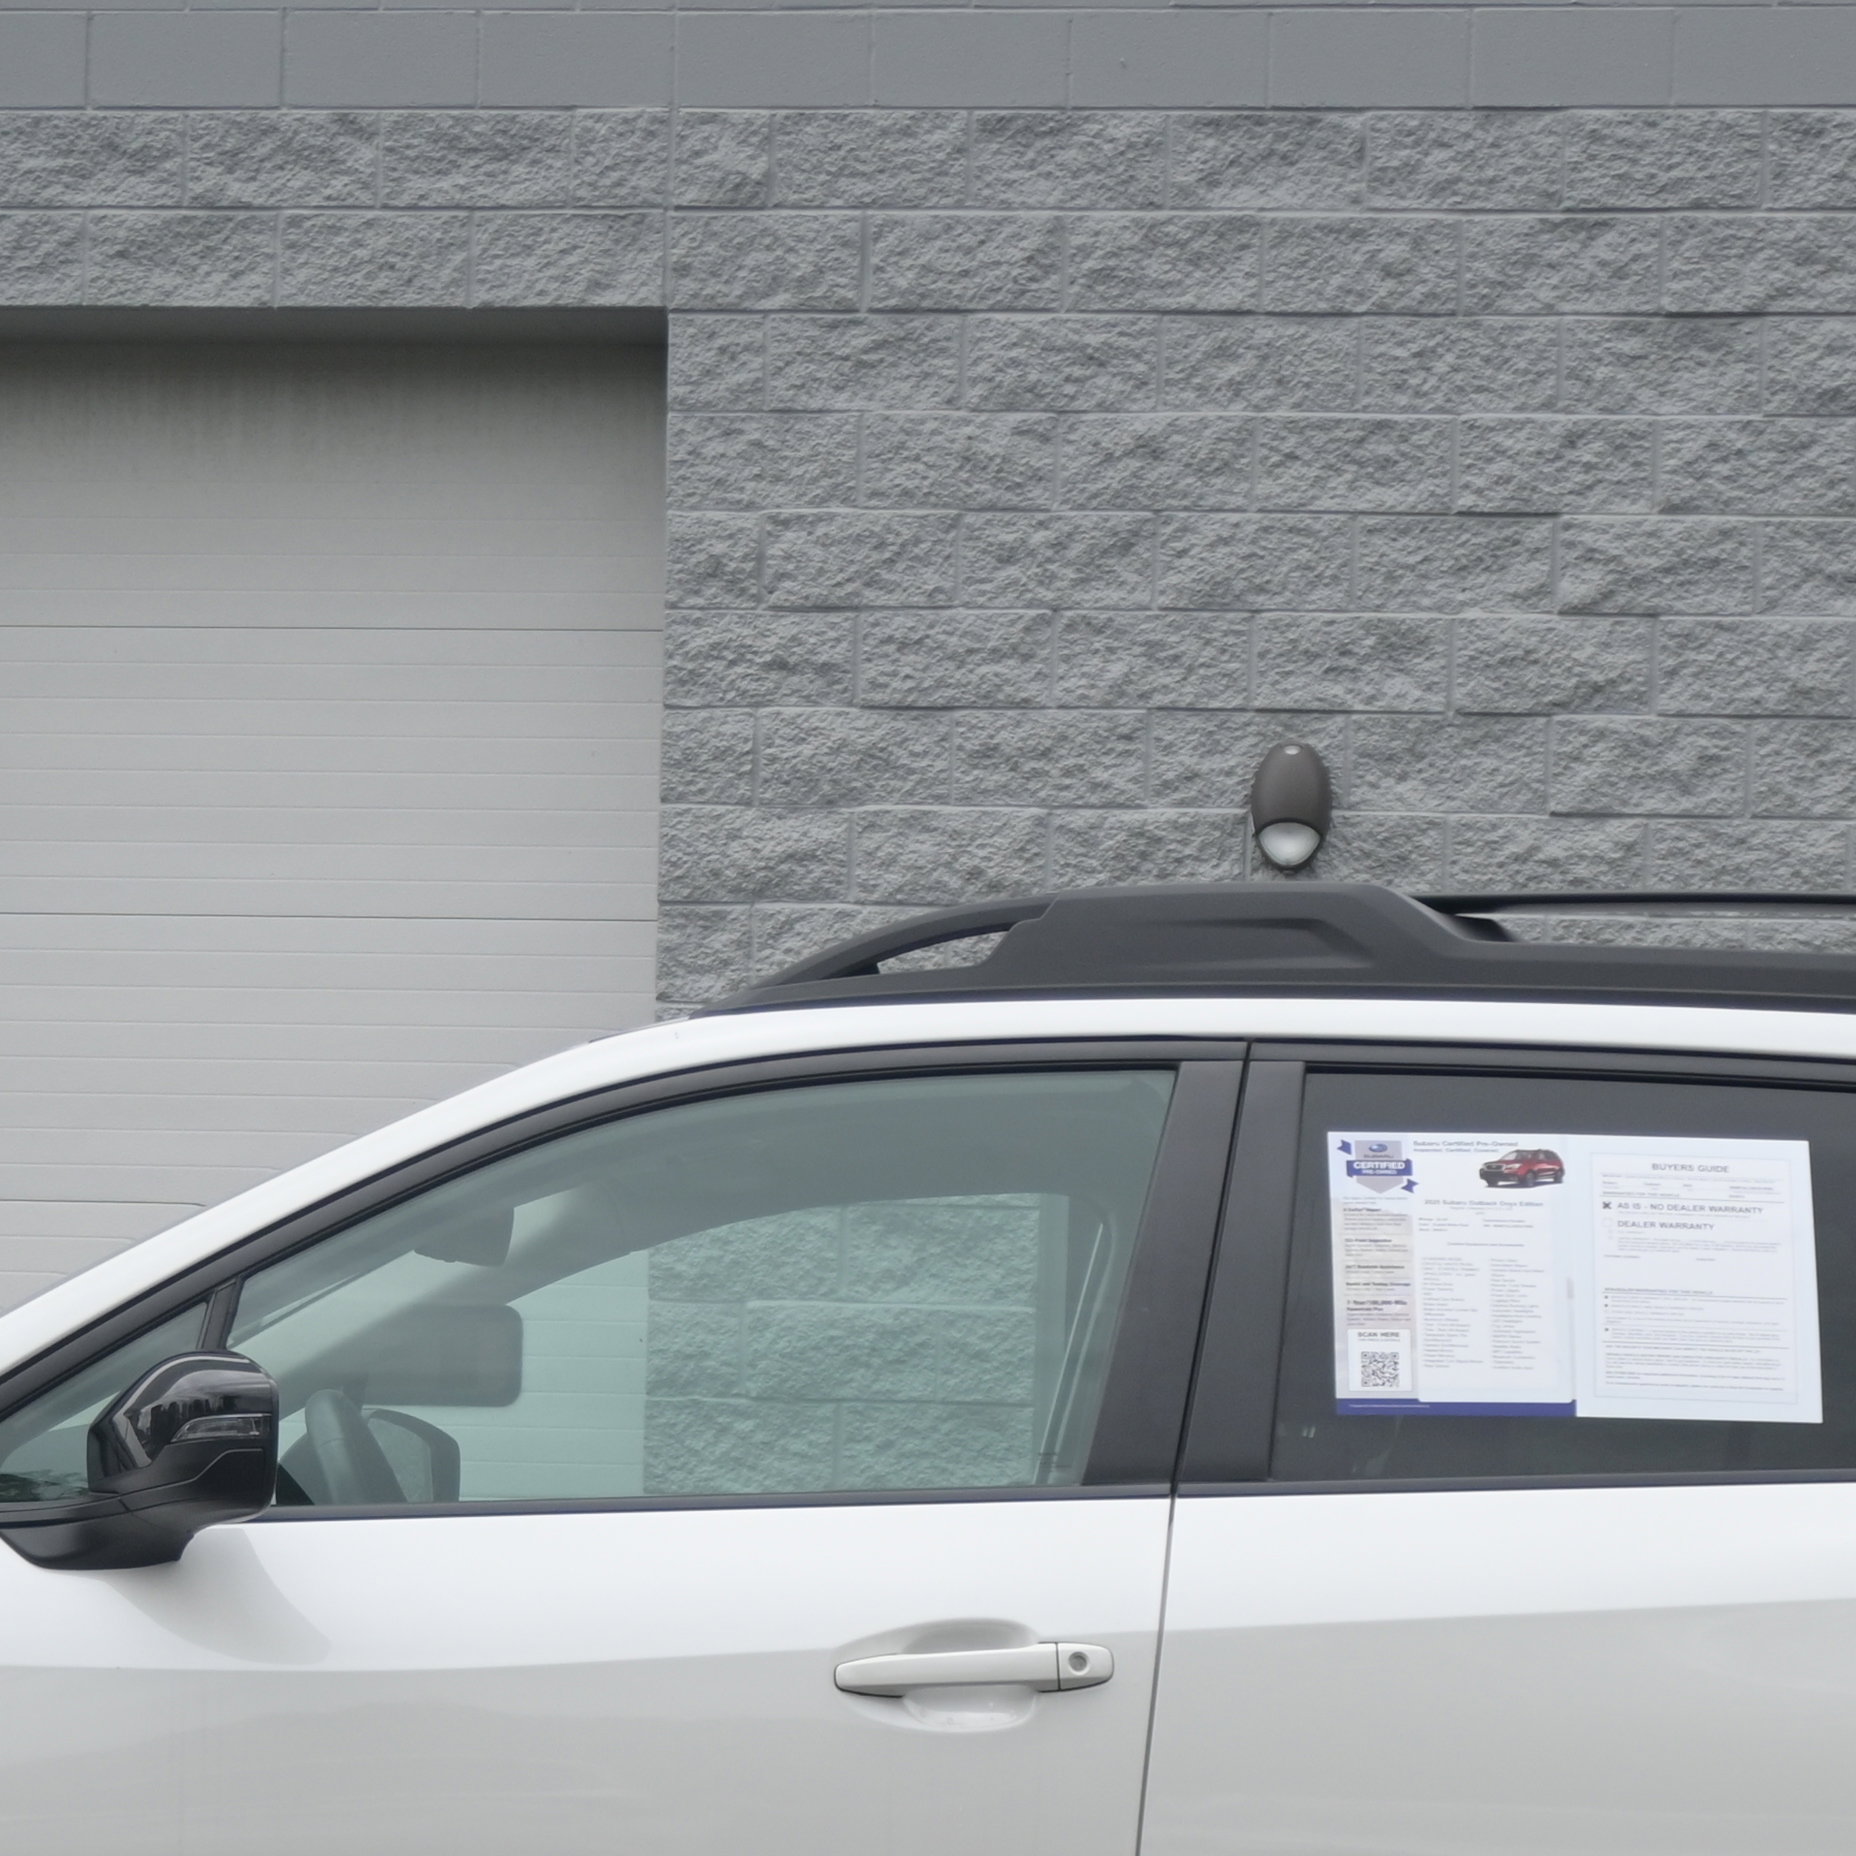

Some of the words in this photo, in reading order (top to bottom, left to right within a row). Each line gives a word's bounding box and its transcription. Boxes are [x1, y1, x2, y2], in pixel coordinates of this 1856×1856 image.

[1353, 1161, 1406, 1170] CERTIFIED
[1651, 1163, 1694, 1172] BUYERS
[1697, 1165, 1730, 1173] GUIDE
[1617, 1202, 1631, 1210] AS
[1650, 1203, 1665, 1211] NO
[1666, 1204, 1706, 1213] DEALER
[1708, 1206, 1764, 1215] WARRANTY
[1617, 1220, 1657, 1228] DEALER
[1659, 1221, 1716, 1231] WARRANTY
